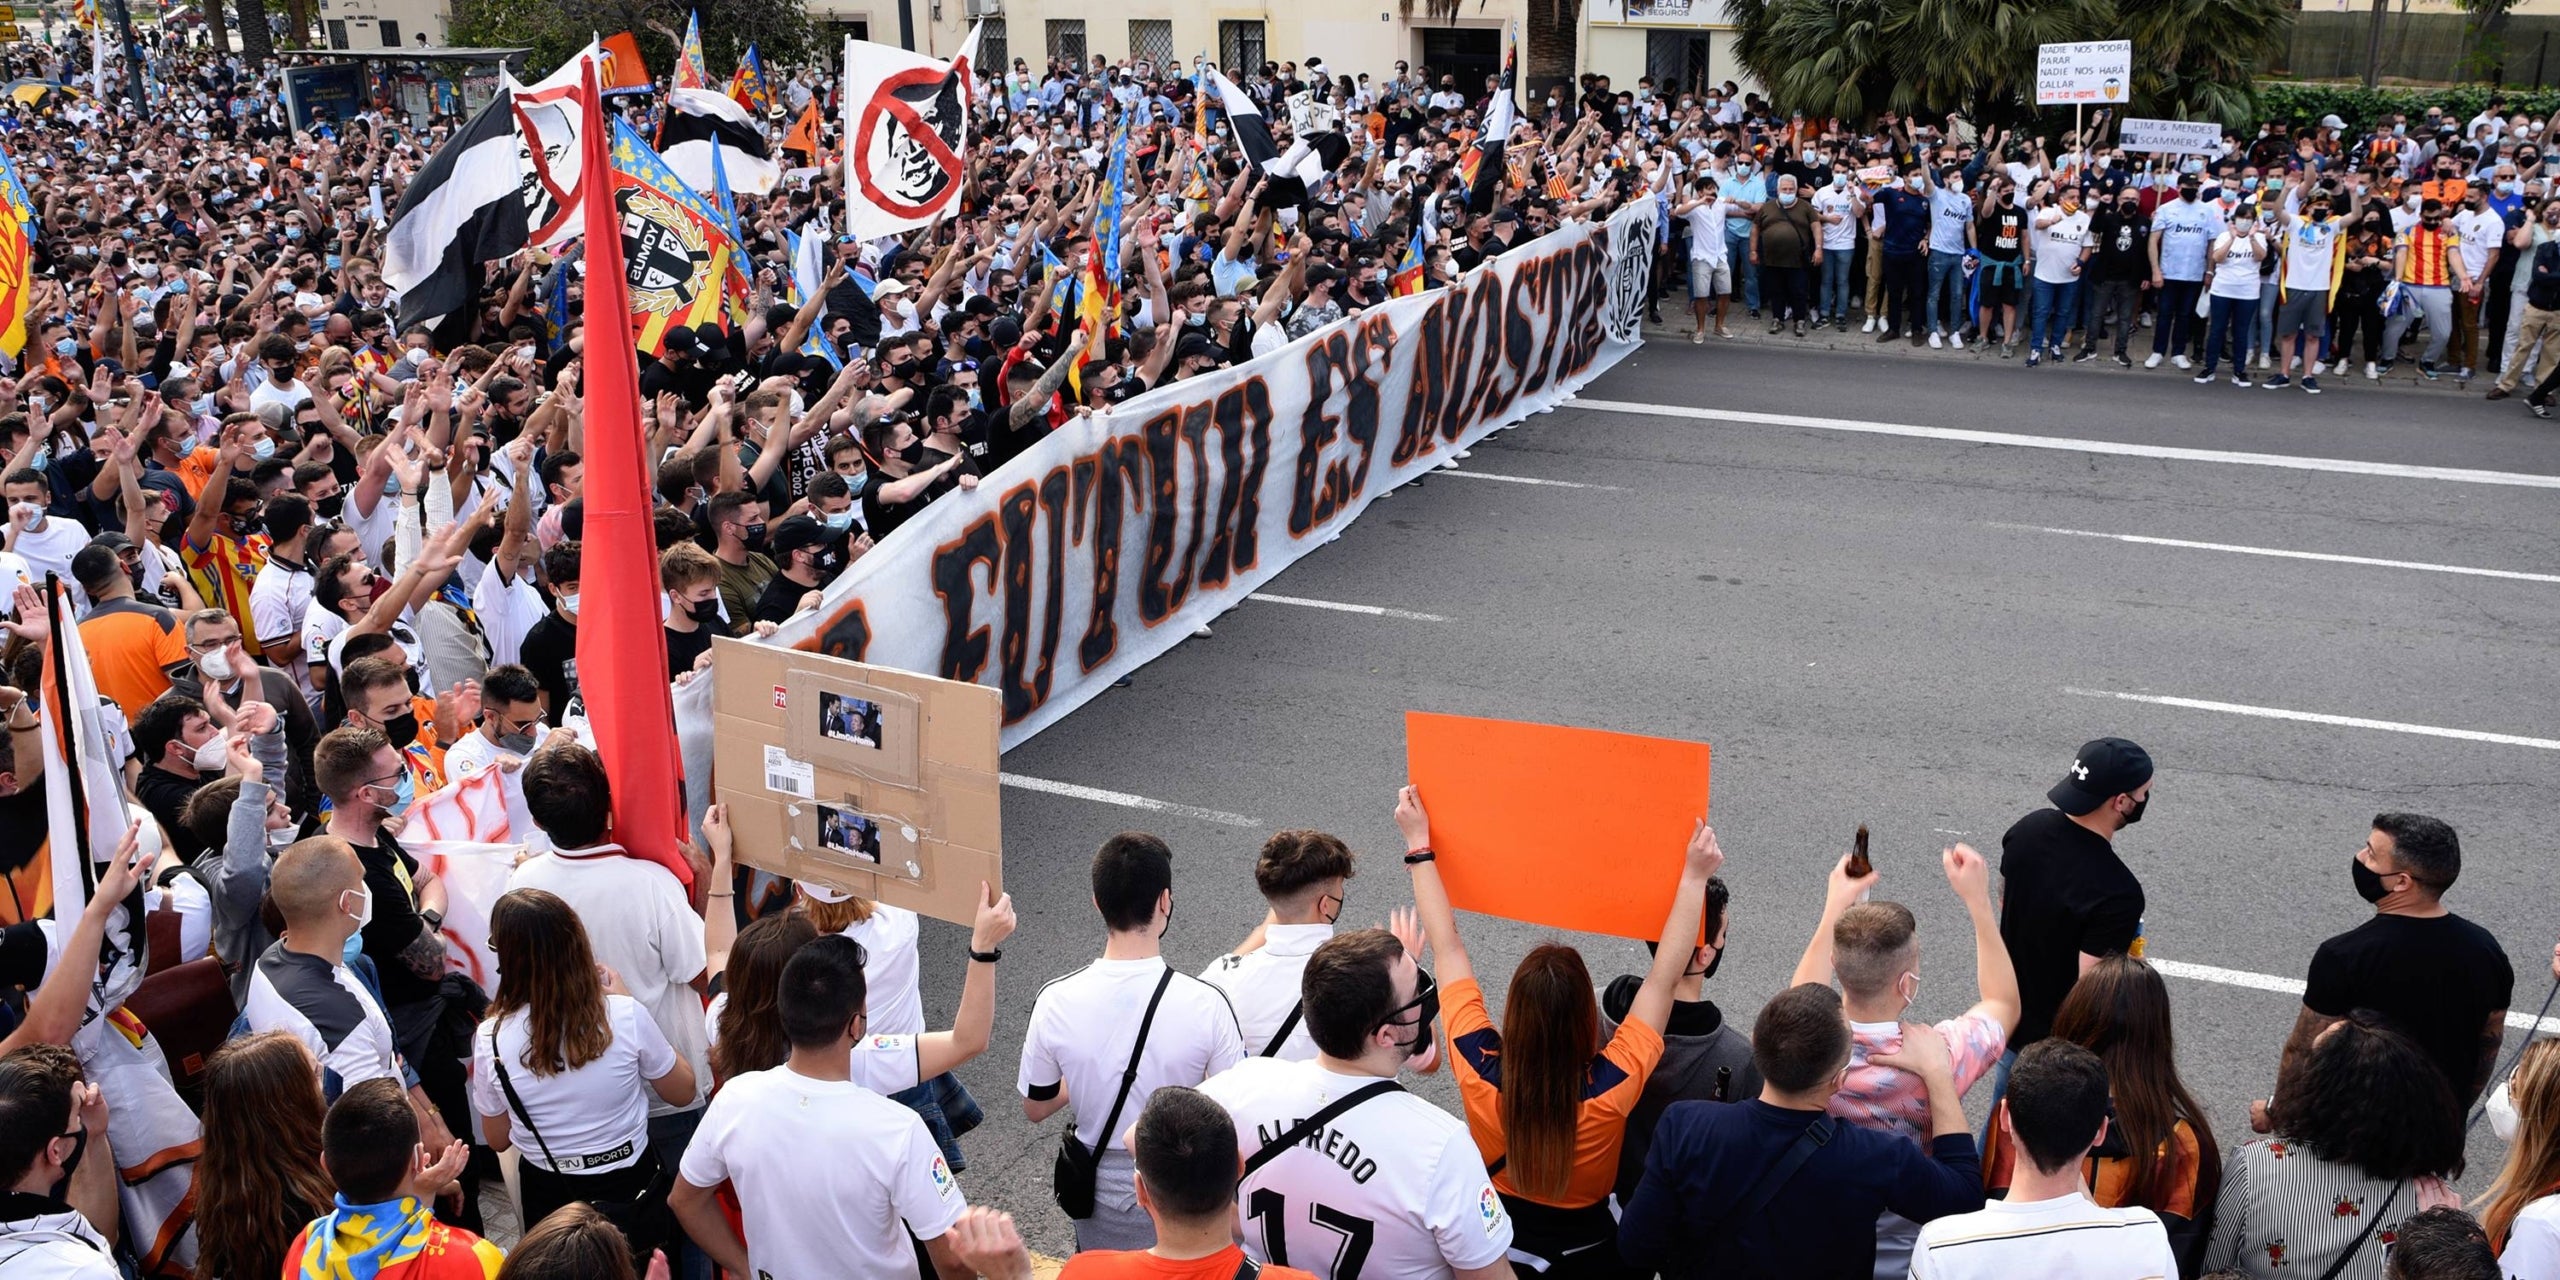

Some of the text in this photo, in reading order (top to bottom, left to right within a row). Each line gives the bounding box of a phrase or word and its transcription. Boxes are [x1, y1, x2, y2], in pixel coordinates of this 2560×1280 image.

[1648, 8, 1690, 17] SEGUROS
[2040, 45, 2067, 55] NADIE
[2073, 44, 2092, 53] NOS
[2040, 56, 2071, 65] PARAR
[2040, 67, 2069, 77] NADIE
[2074, 66, 2094, 75] NOS
[2039, 80, 2075, 89] CALLAR
[2134, 121, 2154, 131] LIM
[2171, 123, 2214, 135] MENDES
[2139, 136, 2199, 147] SCAMMERS
[2002, 215, 2018, 226] LIM
[2002, 226, 2017, 237] GO
[2175, 222, 2202, 234] bwin
[1995, 237, 2019, 249] HOME
[827, 729, 876, 748] #LimGoHome
[586, 1145, 631, 1166] SPORTS
[1246, 1187, 1375, 1280] 17
